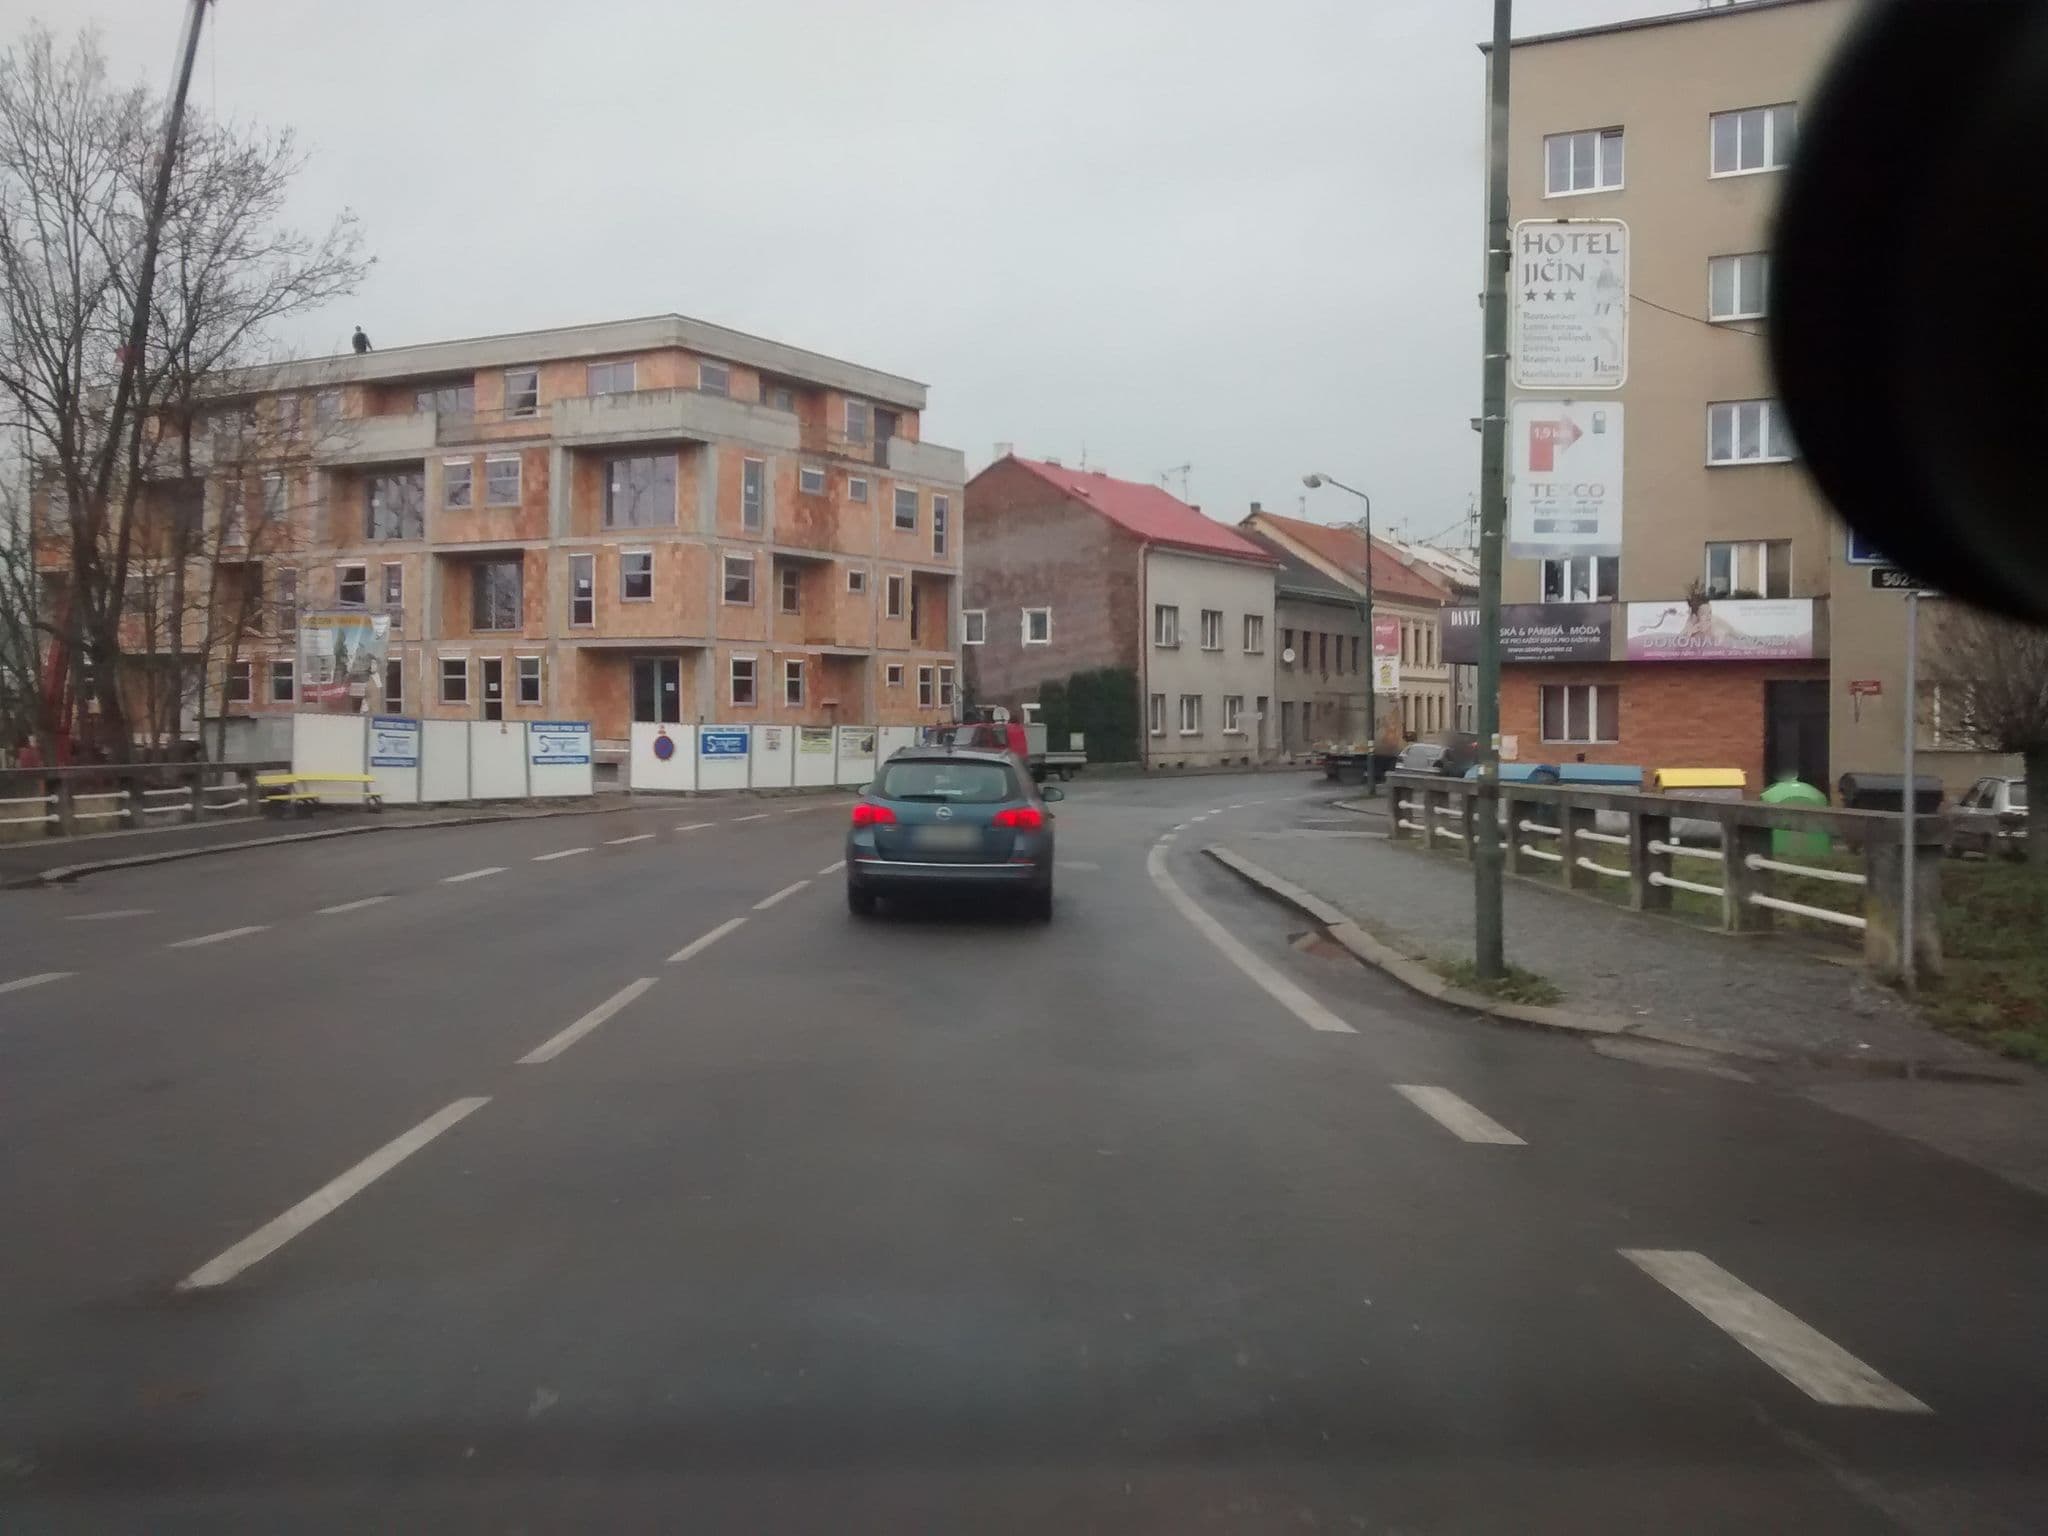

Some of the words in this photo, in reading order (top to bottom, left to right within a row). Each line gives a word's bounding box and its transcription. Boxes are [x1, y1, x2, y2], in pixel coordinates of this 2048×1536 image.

[1522, 232, 1620, 255] HOTEL
[1499, 625, 1517, 636] SKÁ
[1518, 627, 1526, 636] &
[1570, 624, 1601, 635] MÓDA
